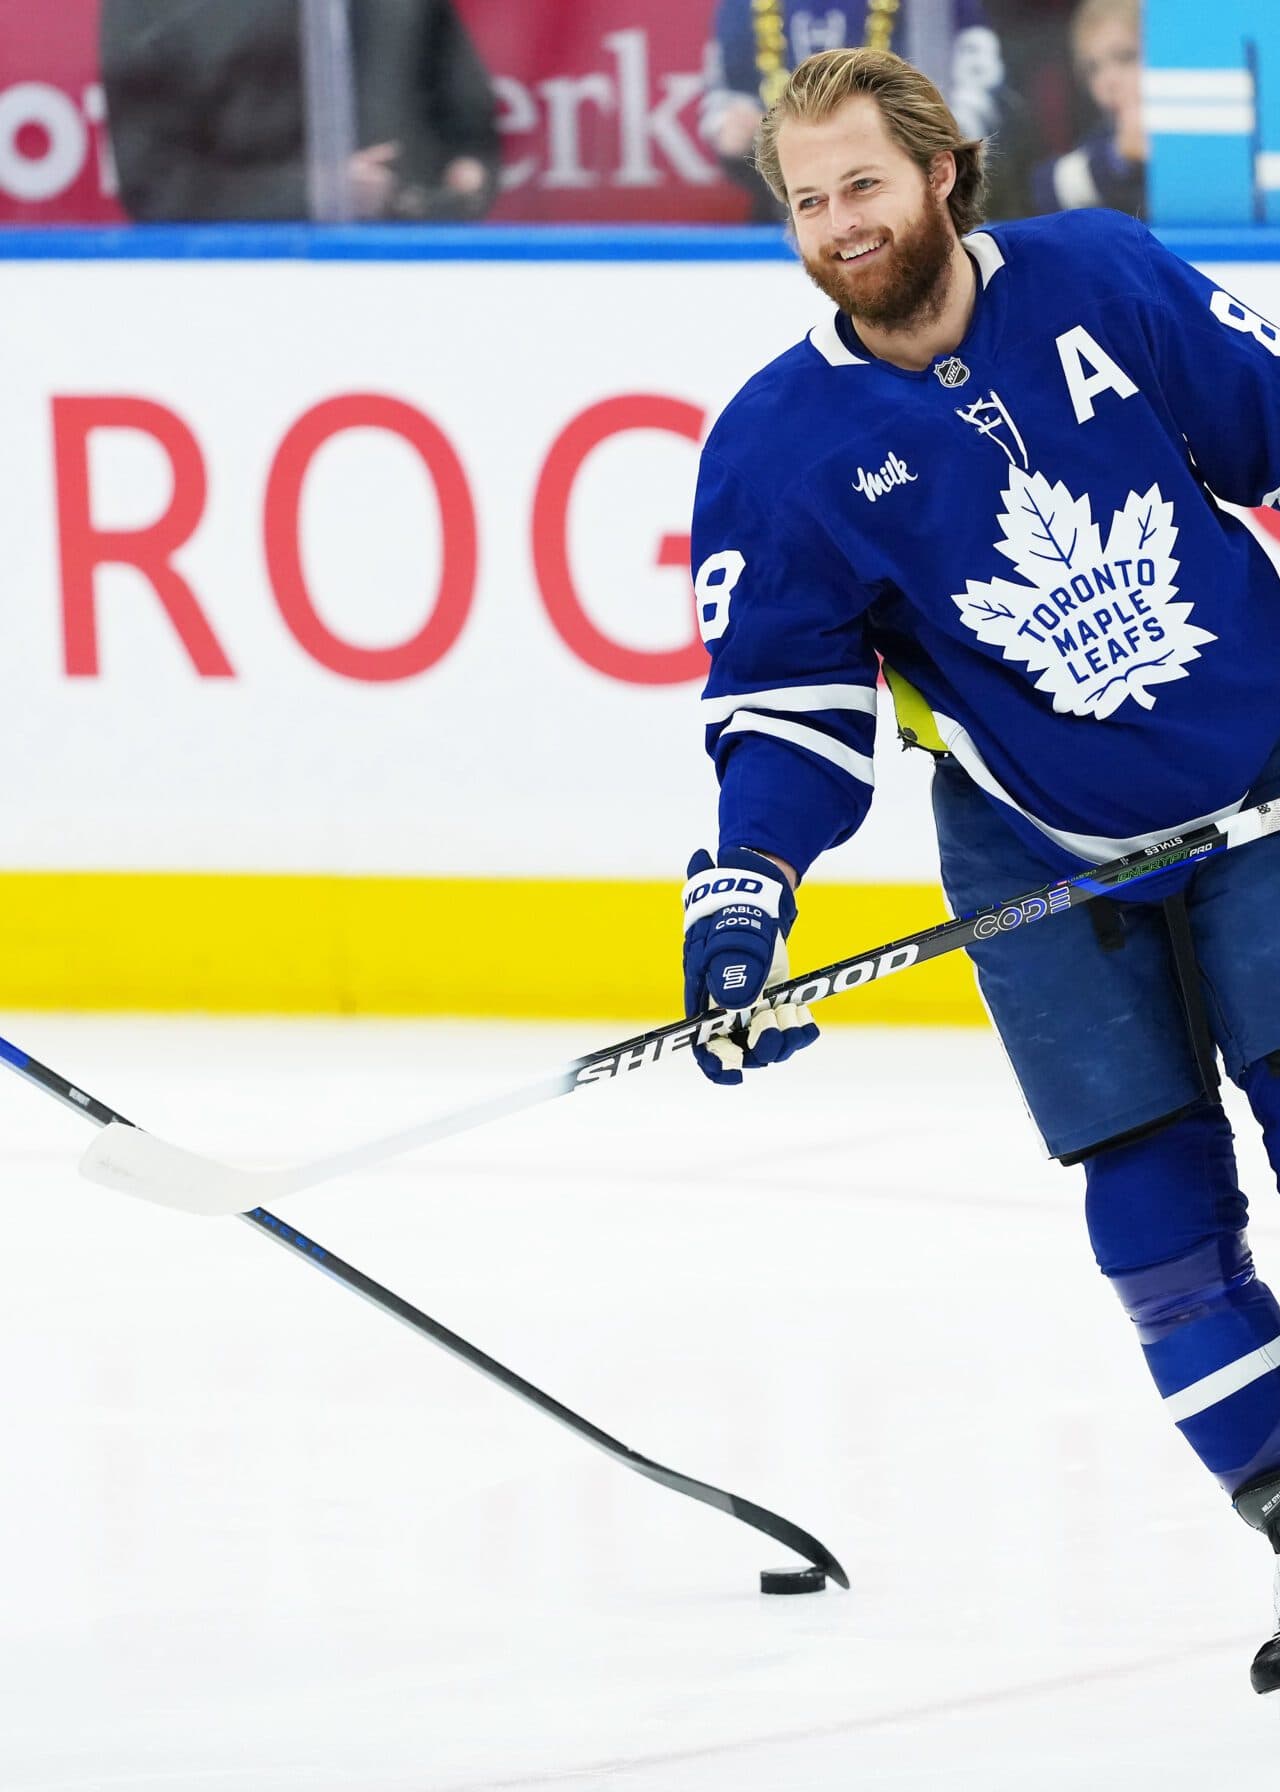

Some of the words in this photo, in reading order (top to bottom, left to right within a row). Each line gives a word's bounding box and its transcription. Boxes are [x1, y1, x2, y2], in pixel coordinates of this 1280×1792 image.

[1055, 325, 1140, 425] A
[694, 549, 747, 644] 8
[1017, 558, 1156, 643] TORONTO
[1051, 588, 1152, 658] MAPLE
[1066, 616, 1166, 684] LEAFS
[1144, 836, 1184, 857] STYLES
[722, 905, 763, 918] PABLO
[973, 885, 1072, 939] CODE
